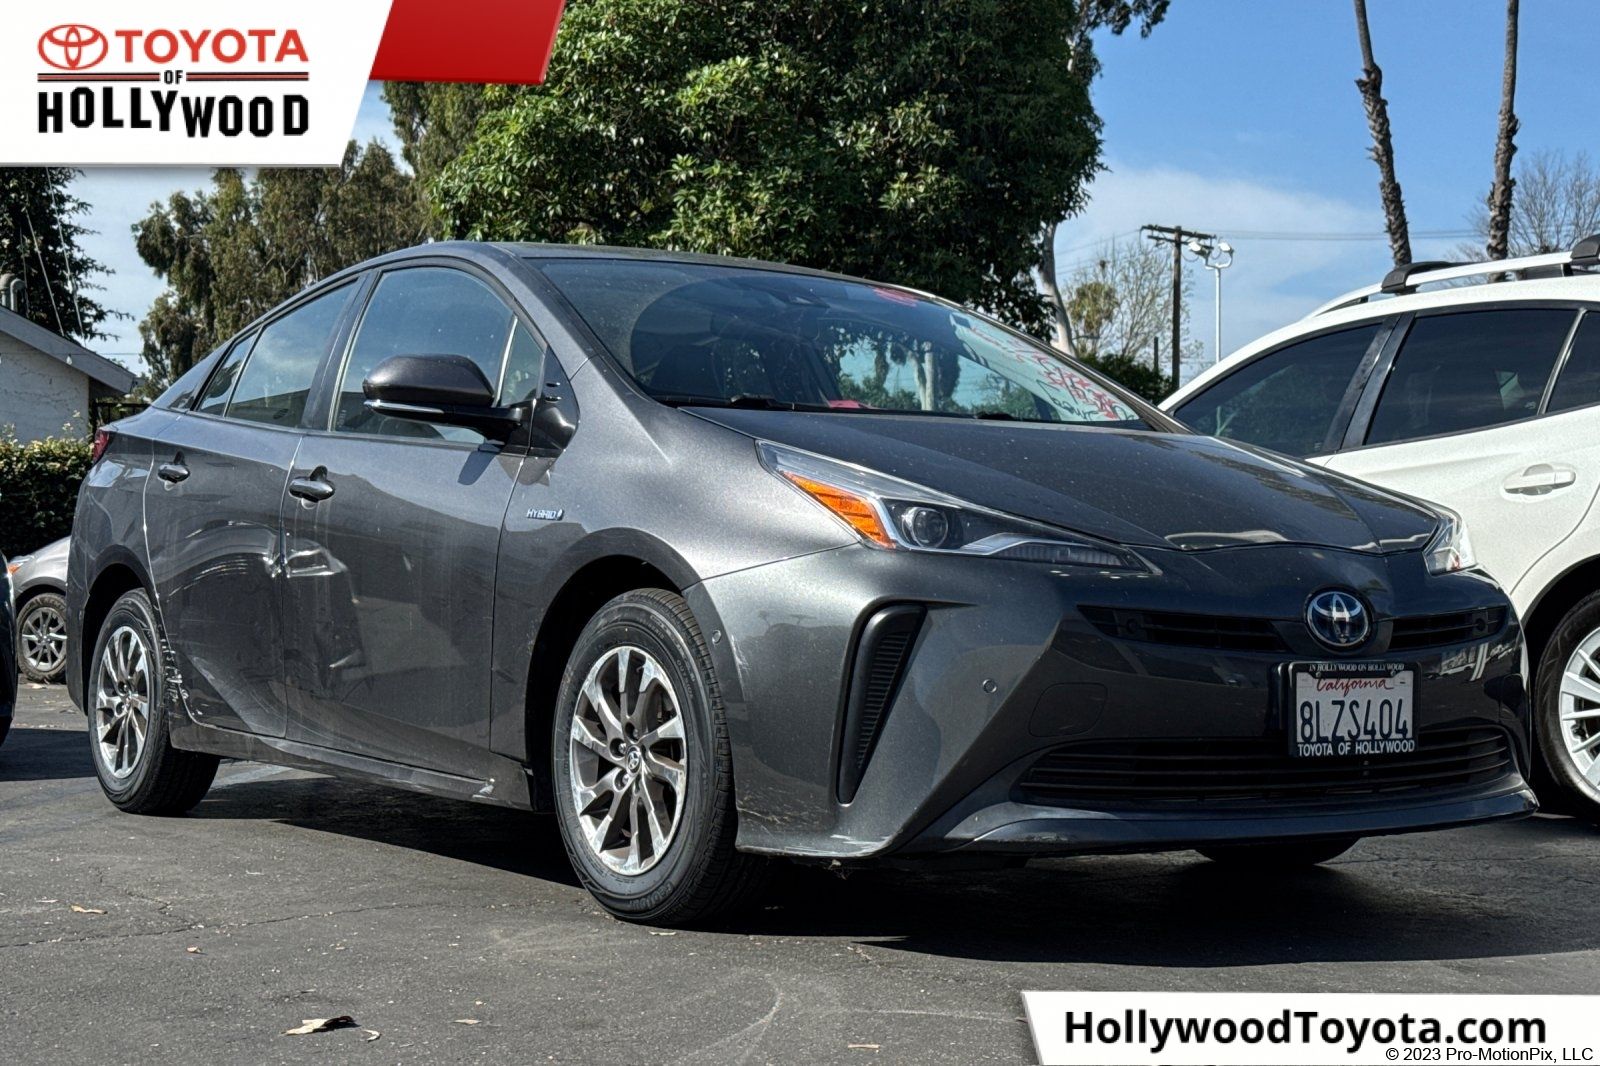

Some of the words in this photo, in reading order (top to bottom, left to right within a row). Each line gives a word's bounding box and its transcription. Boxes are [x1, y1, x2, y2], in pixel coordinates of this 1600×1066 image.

[526, 508, 556, 520] HYBRID
[1316, 679, 1393, 697] California
[1300, 699, 1409, 742] 8LZS404
[1298, 743, 1333, 757] TOYOTA
[1338, 742, 1352, 756] OF
[1355, 741, 1415, 754] HOLLYWOOD
